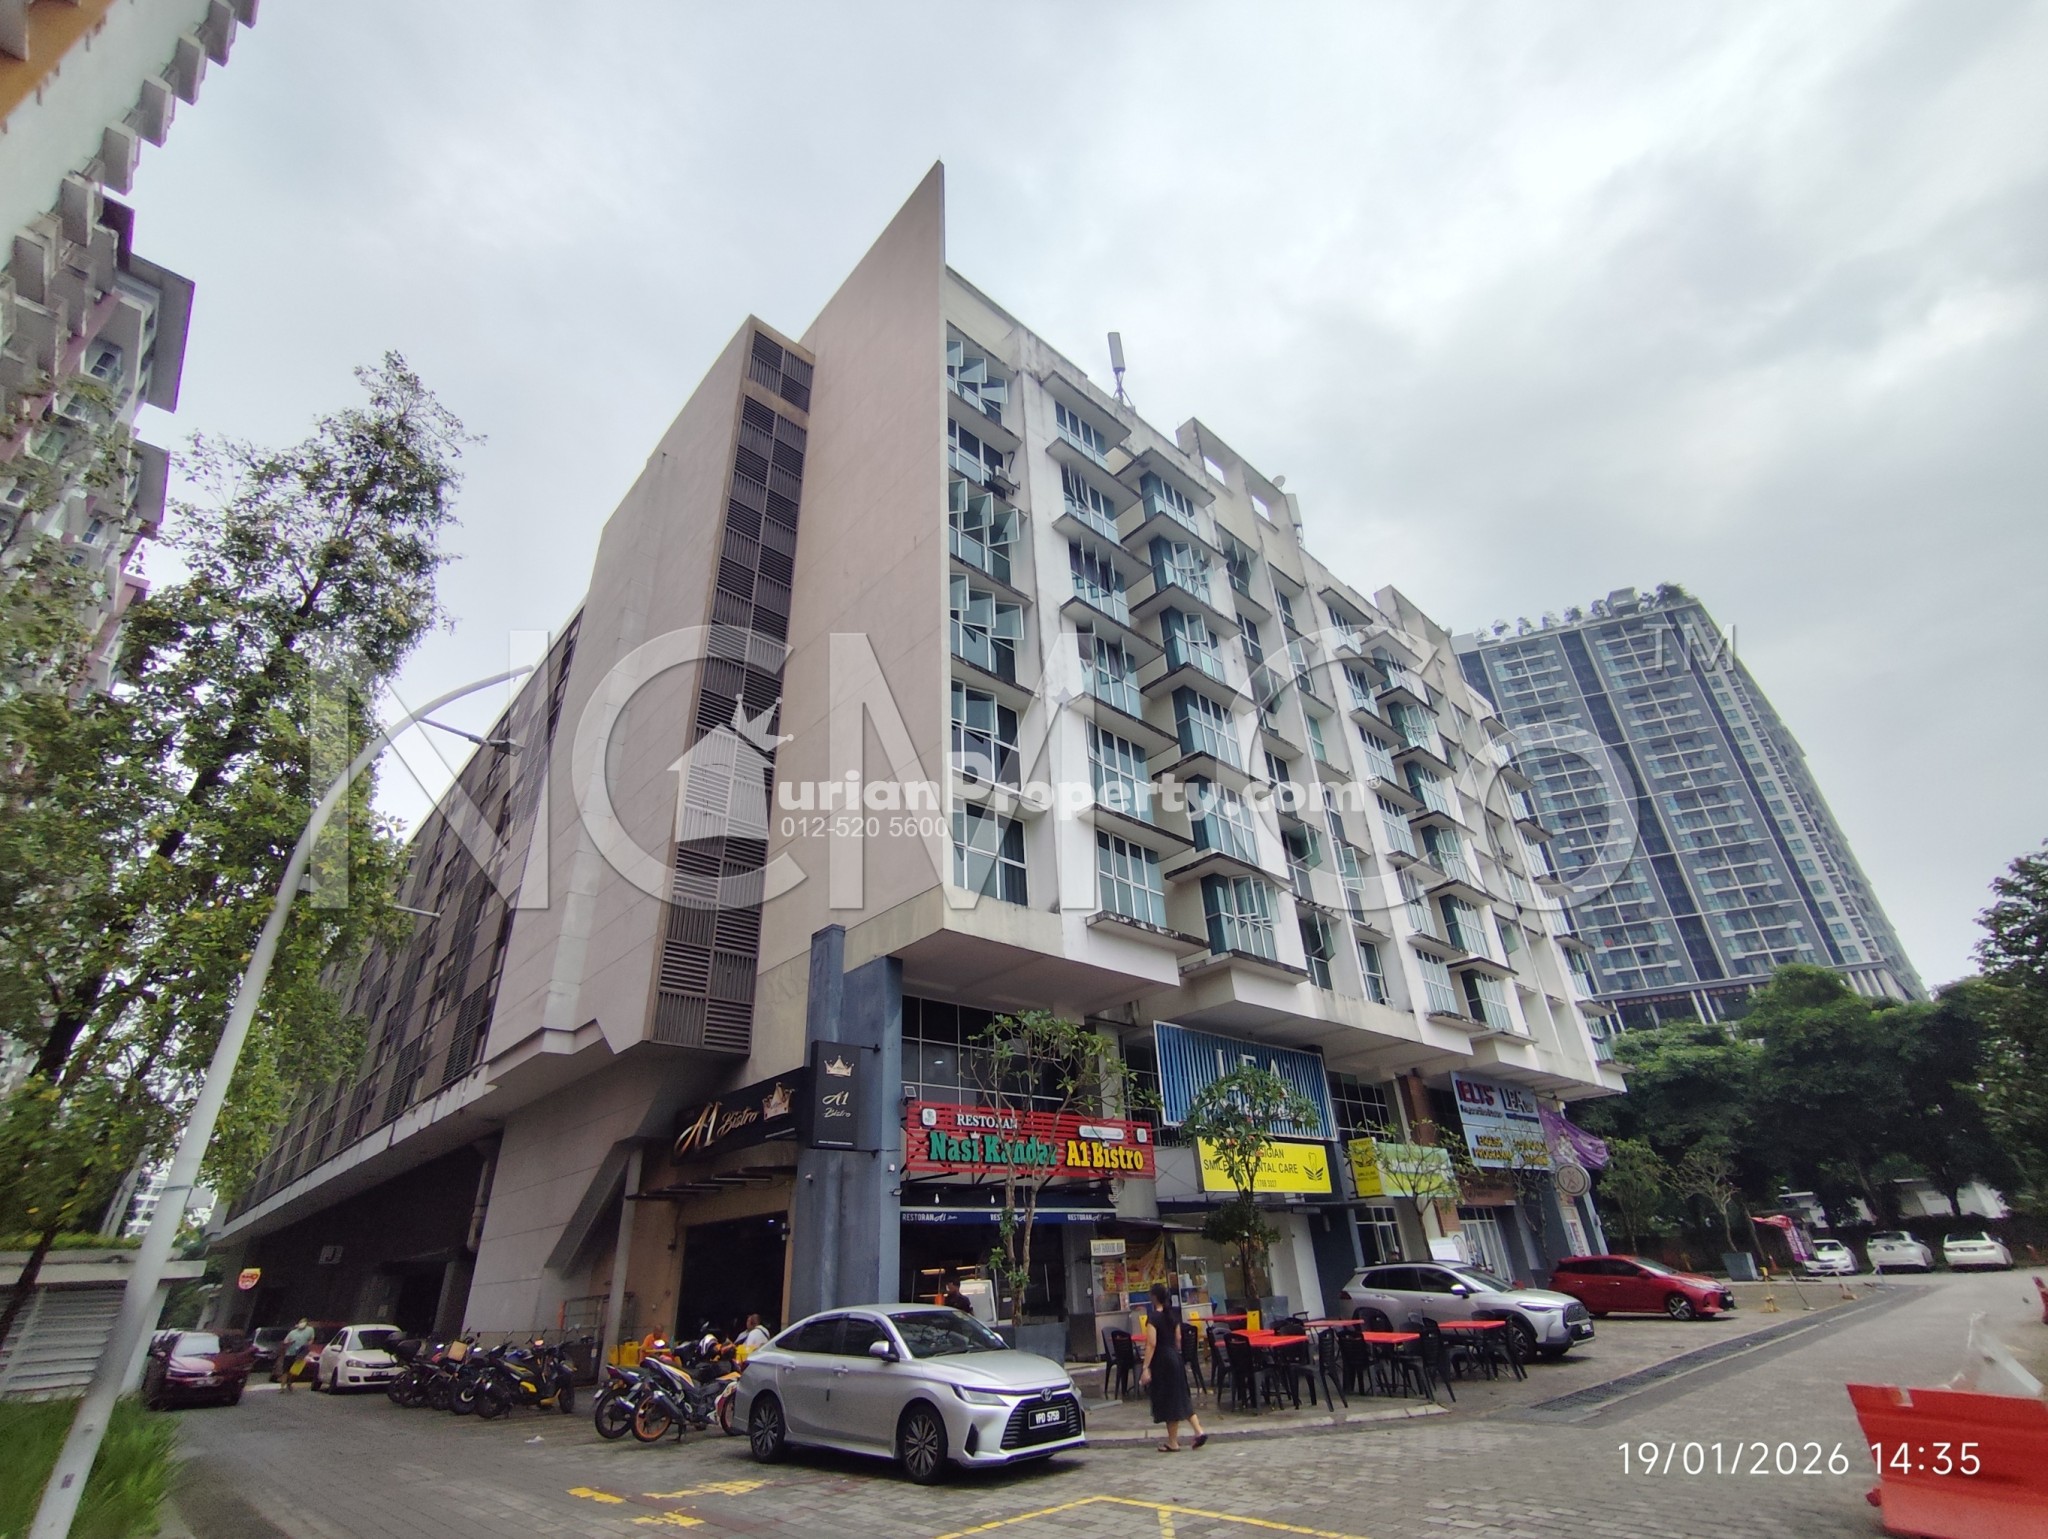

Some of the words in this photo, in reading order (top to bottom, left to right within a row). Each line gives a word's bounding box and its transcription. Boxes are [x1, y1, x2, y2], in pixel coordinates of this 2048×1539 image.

[822, 1091, 849, 1107] A1
[716, 1106, 760, 1137] Bistro
[928, 1130, 980, 1162] Nasi
[1066, 1140, 1092, 1167] A1
[1091, 1141, 1144, 1170] Bistro
[1278, 1163, 1299, 1174] CARE
[902, 1213, 934, 1221] RESTORAN
